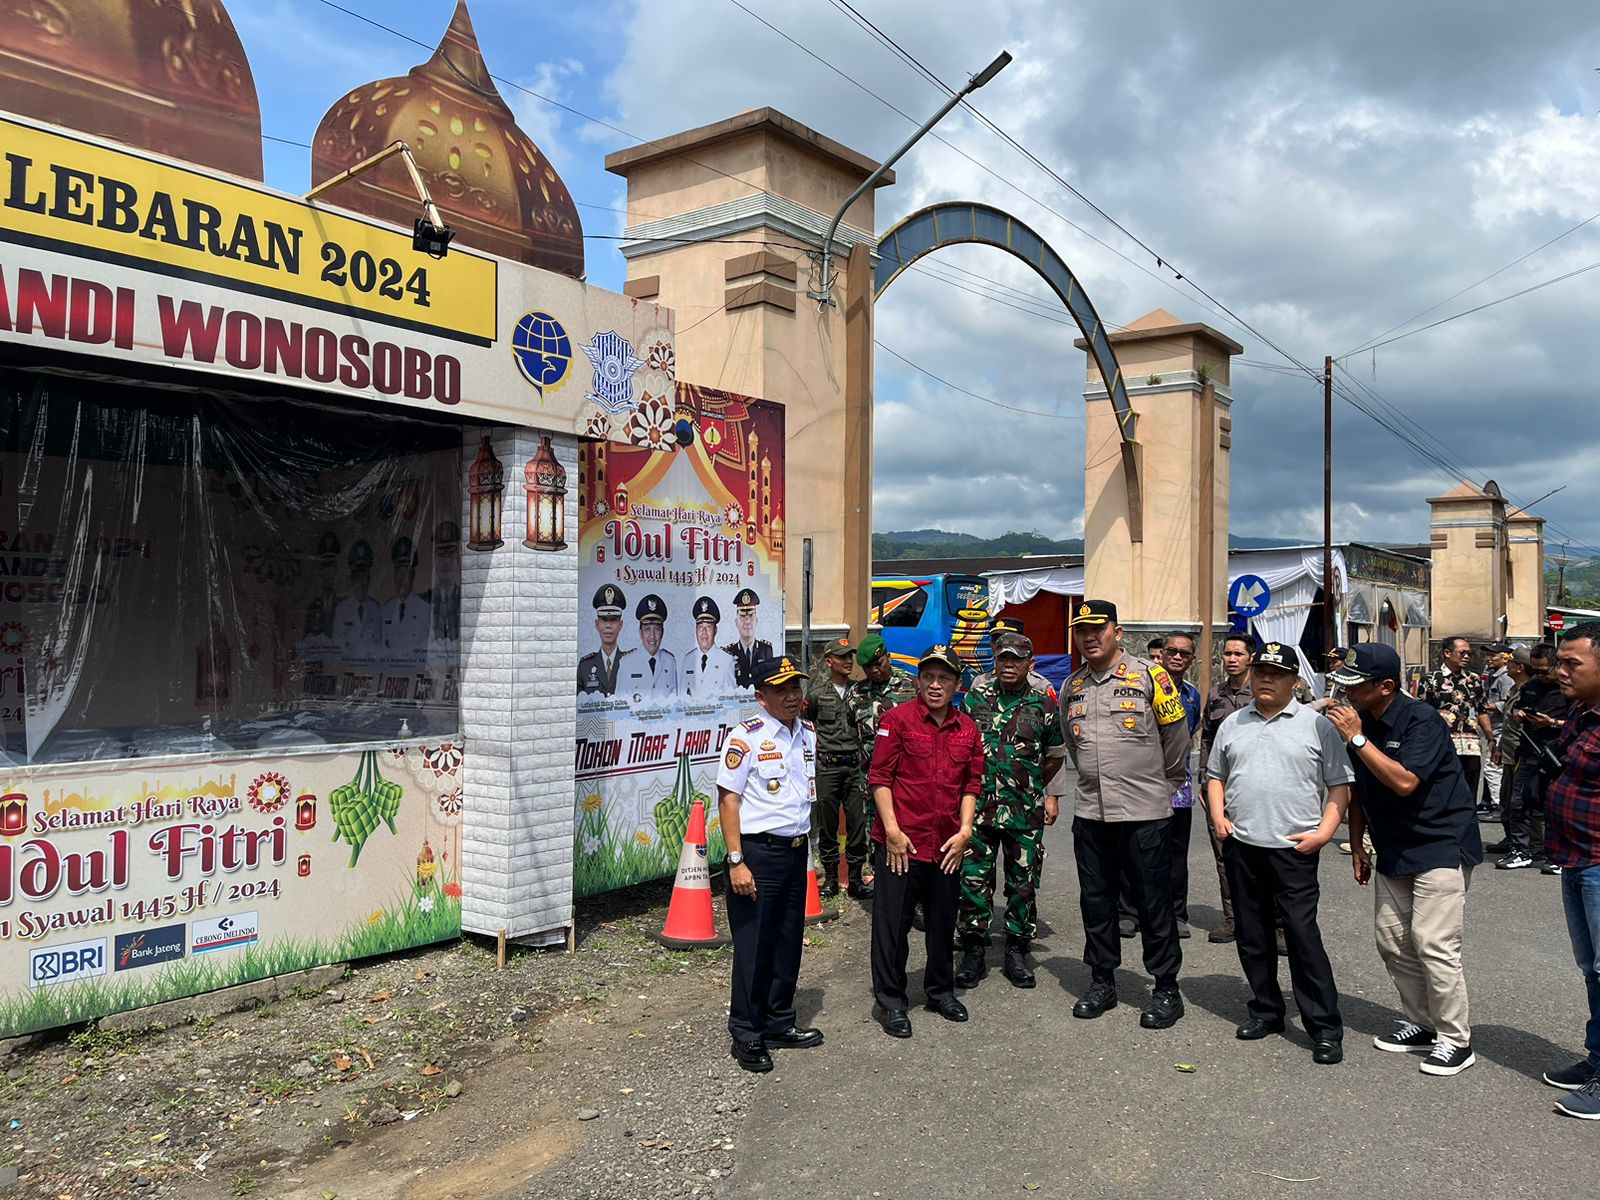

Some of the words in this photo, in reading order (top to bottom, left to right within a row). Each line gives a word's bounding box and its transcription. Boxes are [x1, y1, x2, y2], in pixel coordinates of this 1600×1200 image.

[4, 151, 304, 275] LEBARAN
[321, 240, 431, 308] 2024
[0, 263, 135, 351] NDI
[157, 295, 461, 405] WONOSOBO
[630, 503, 670, 518] Selamat
[670, 506, 695, 522] Hari
[697, 509, 721, 525] Raya
[604, 519, 672, 560] Idul
[680, 526, 742, 563] Fitri
[616, 567, 621, 578] 1
[623, 564, 665, 583] Syawal
[669, 570, 692, 584] 1445
[715, 572, 740, 586] 2024
[575, 737, 623, 772] MOHON
[673, 728, 712, 758] LAHIR
[33, 806, 126, 833] Selamat
[130, 796, 182, 824] Hari
[187, 795, 240, 816] Raya
[149, 816, 286, 878] Fitri
[18, 898, 113, 938] Syawal
[121, 895, 176, 921] 1445
[228, 879, 280, 901] 2024
[131, 946, 154, 959] Bank
[153, 942, 181, 957] Jateng
[195, 933, 222, 945] CEBONG
[223, 926, 255, 940] IMELINDO
[62, 945, 103, 975] BRI
